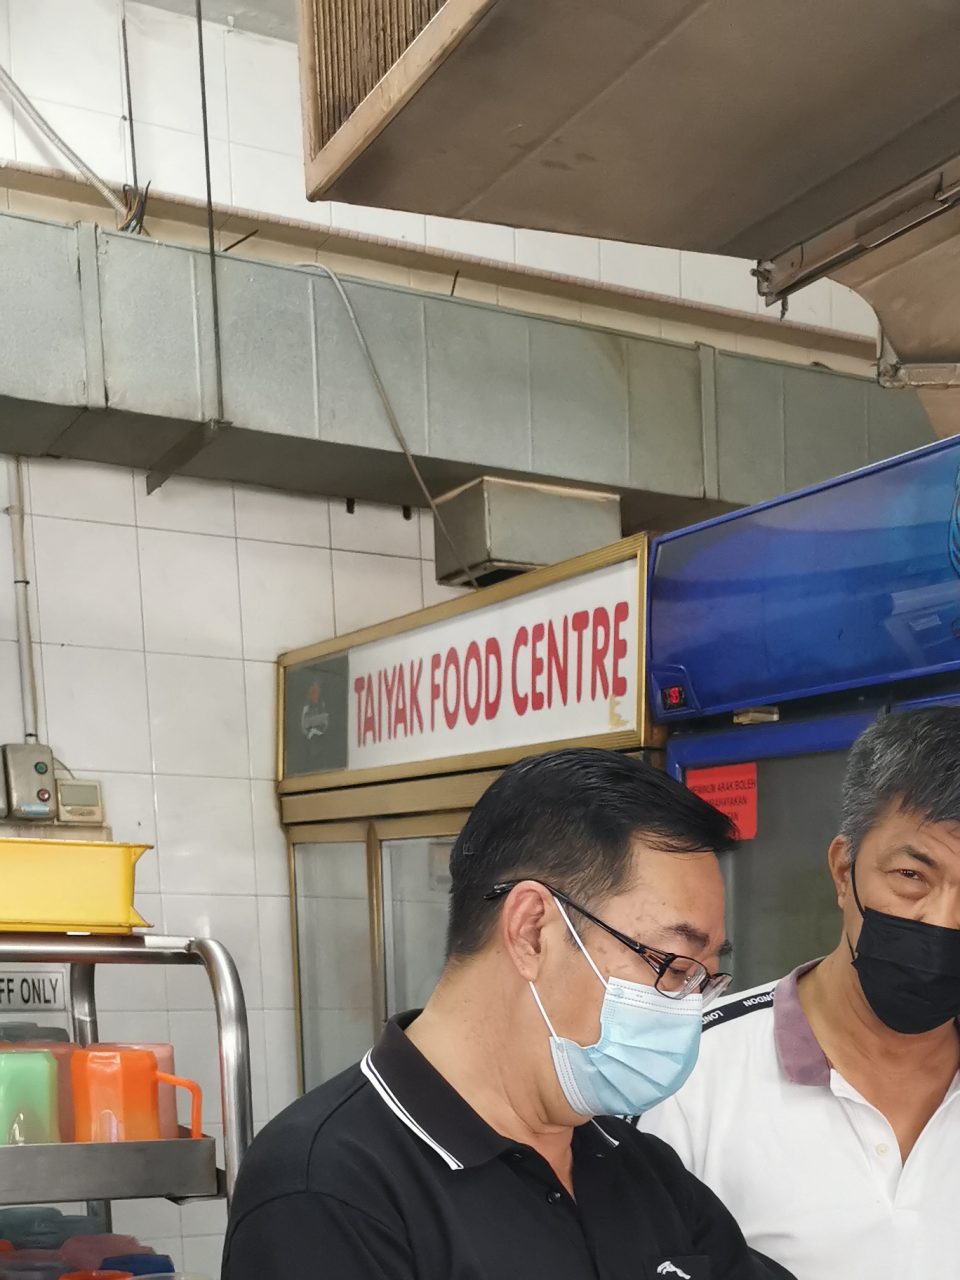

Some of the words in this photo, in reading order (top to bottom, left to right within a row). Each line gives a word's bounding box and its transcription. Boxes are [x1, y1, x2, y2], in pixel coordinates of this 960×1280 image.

[354, 656, 424, 748] TAIYAK
[430, 636, 502, 732] FOOD
[511, 601, 629, 716] CENTRE
[20, 978, 58, 1004] ONLY
[743, 990, 776, 1007] ONDON
[701, 1010, 724, 1025] LOND
